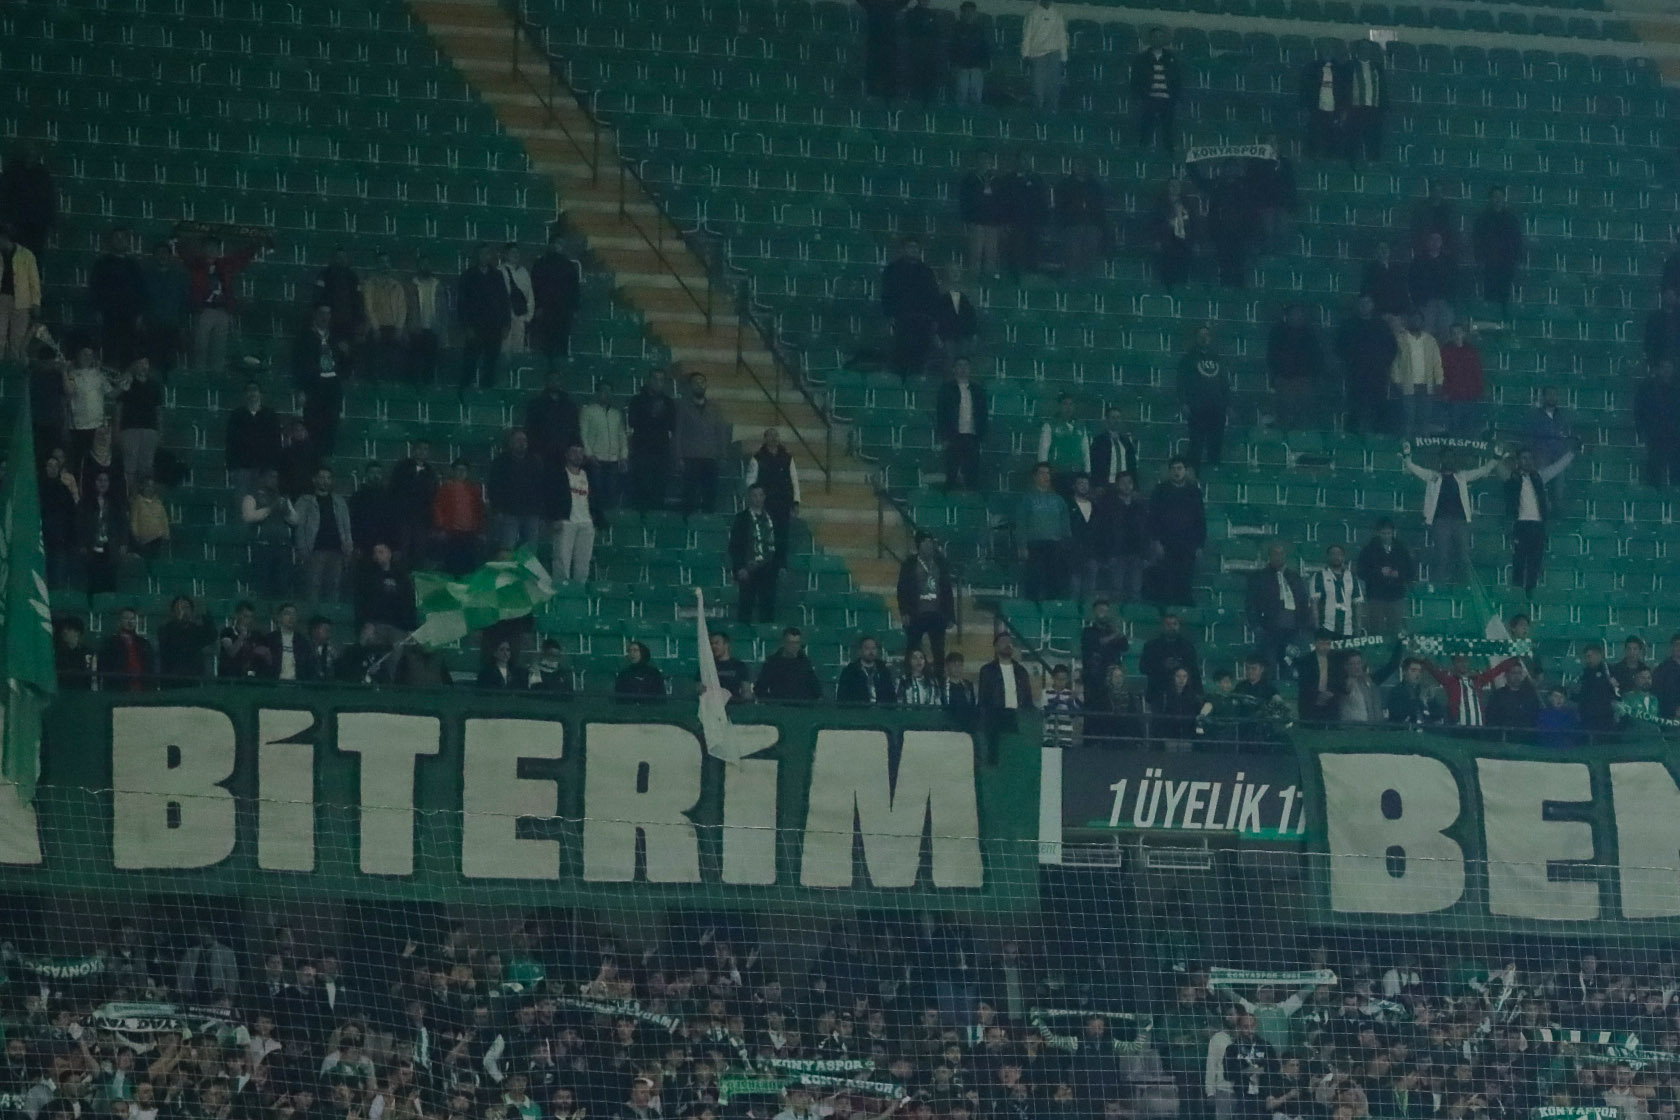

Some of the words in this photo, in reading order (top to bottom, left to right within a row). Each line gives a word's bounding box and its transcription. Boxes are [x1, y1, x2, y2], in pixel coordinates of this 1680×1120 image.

[1416, 437, 1487, 450] KONYASPOR
[1109, 778, 1128, 827] 1
[1133, 767, 1270, 832] ÜYELİK
[802, 1074, 896, 1093] KONYASPOR
